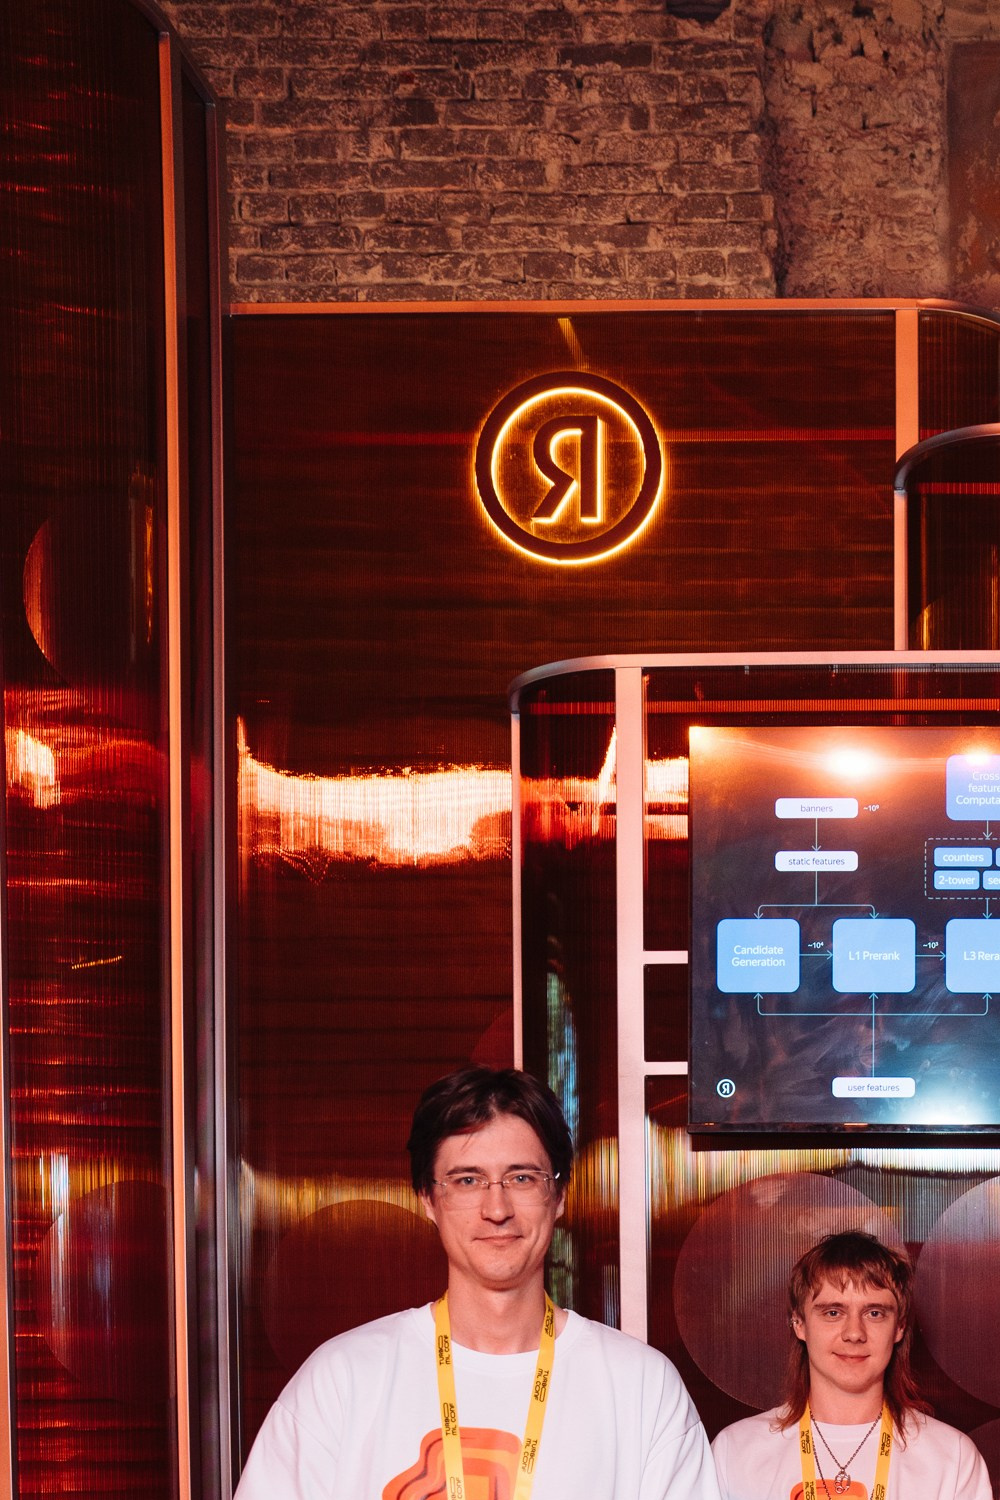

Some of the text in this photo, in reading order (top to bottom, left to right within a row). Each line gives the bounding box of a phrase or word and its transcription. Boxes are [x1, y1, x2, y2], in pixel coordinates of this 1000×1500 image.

[800, 804, 833, 813] banners
[788, 857, 845, 866] static features
[942, 853, 984, 862] counters
[938, 875, 975, 885] 2-tower
[733, 945, 784, 955] Candidate
[848, 951, 900, 961] L1 Prerank
[963, 951, 976, 961] L3
[731, 957, 786, 967] Generation
[867, 1083, 900, 1092] features
